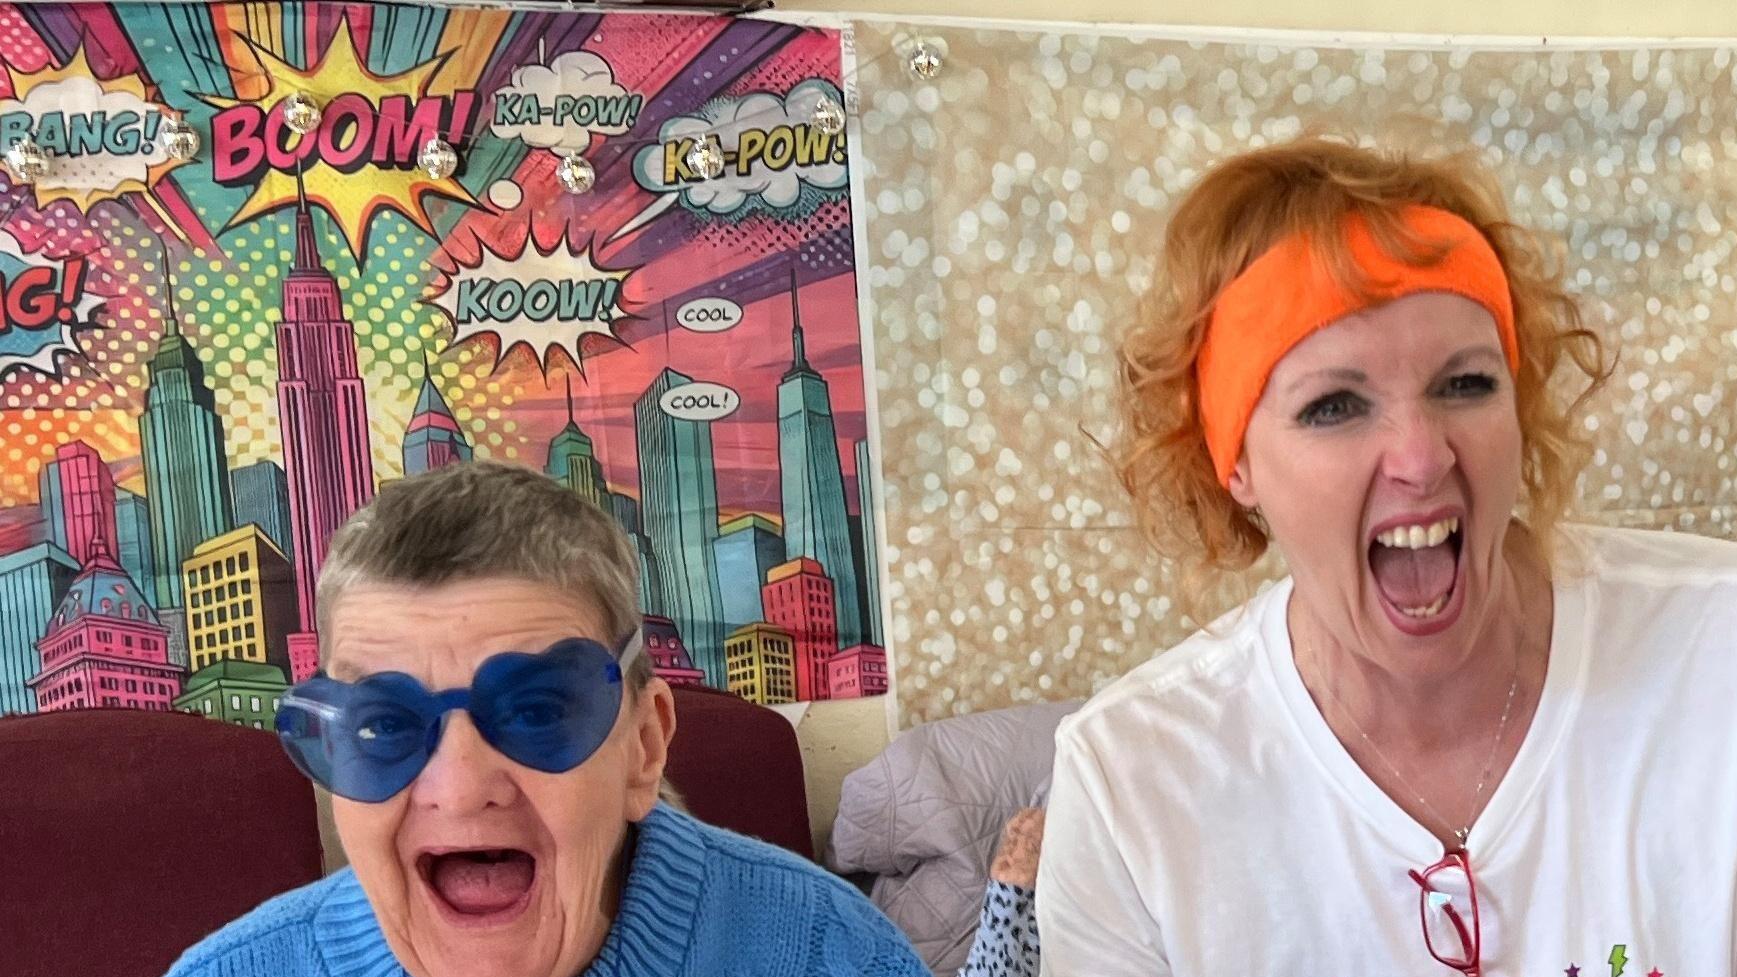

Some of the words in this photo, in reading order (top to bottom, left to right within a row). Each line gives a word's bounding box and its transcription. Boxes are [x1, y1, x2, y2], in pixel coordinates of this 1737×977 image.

[495, 93, 642, 128] KA-POW!
[0, 109, 162, 158] BANG!
[213, 91, 477, 184] BOOM!
[0, 255, 87, 332] G!
[458, 278, 622, 323] KOOW!
[683, 308, 733, 322] COOL
[670, 392, 729, 409] COOL!
